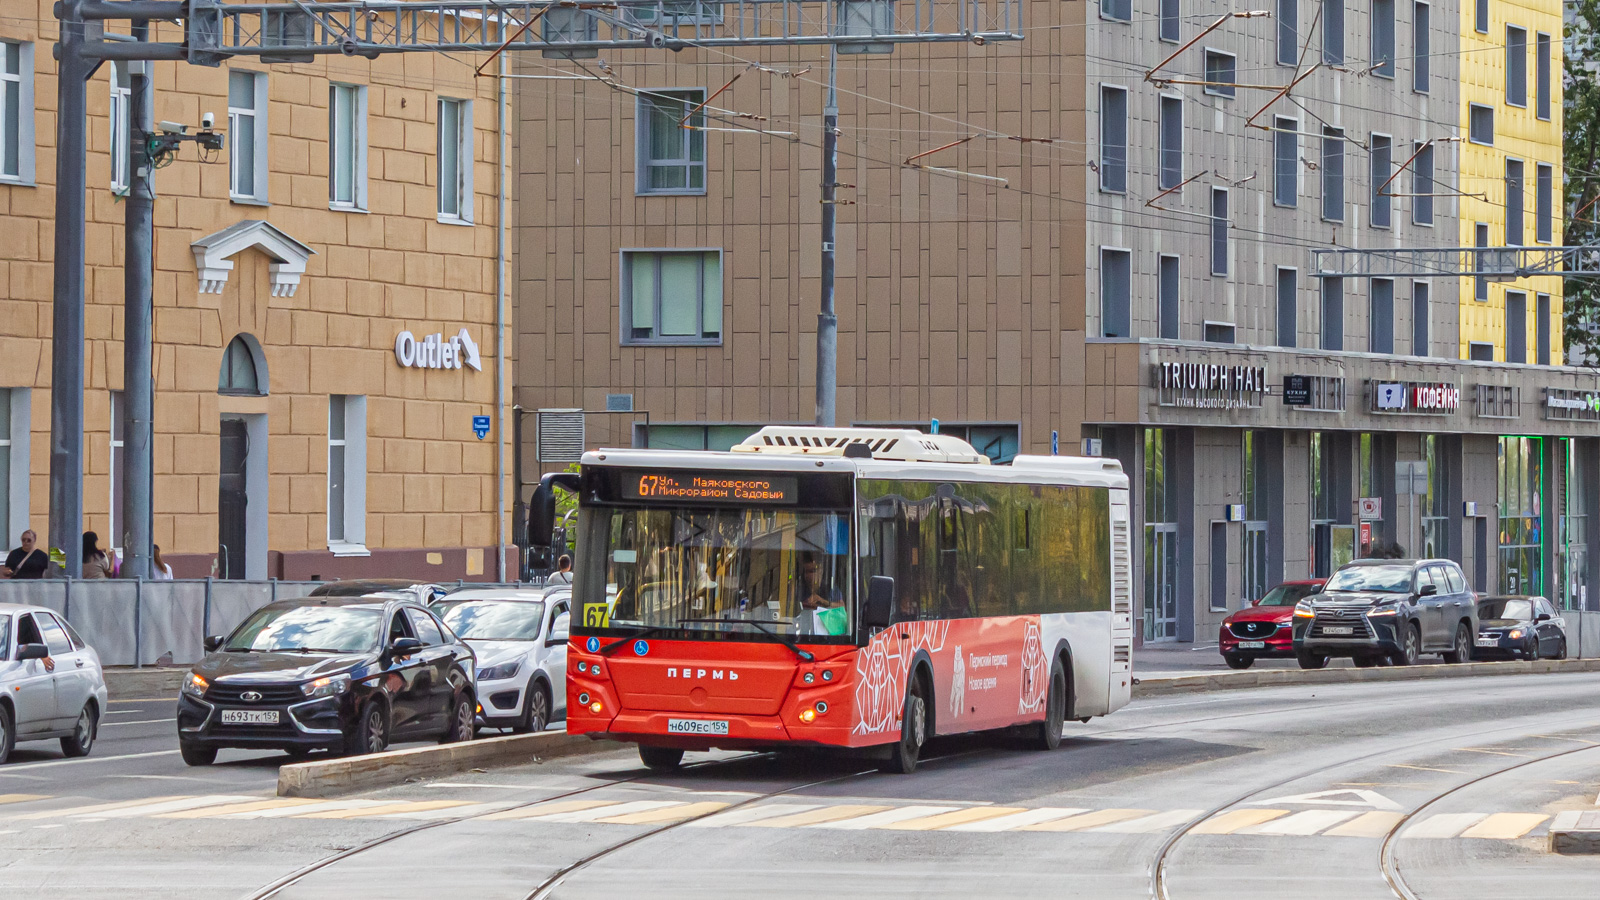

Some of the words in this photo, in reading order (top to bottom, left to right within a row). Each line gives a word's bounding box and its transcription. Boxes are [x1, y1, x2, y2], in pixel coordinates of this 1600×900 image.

[395, 330, 461, 369] Outlet
[1162, 362, 1228, 390] TRIUMPH
[1235, 365, 1270, 392] HALL
[1176, 397, 1194, 407] КУХНИ
[1196, 398, 1225, 409] ВЫСОКОГО
[1226, 399, 1250, 410] ДИЗАЙНА
[1417, 383, 1460, 409] КОФЕЙНЯ
[639, 475, 658, 496] 67
[658, 476, 679, 487] Ул.
[693, 477, 770, 489] Маяковского
[658, 486, 728, 498] Микрорайон
[734, 488, 784, 499] Садовый
[586, 606, 608, 627] 67
[969, 653, 991, 671] Пермский
[992, 654, 1008, 670] период
[667, 668, 739, 680] ПЕРМЬ
[968, 676, 982, 690] Новое
[983, 677, 997, 692] время
[224, 711, 260, 721] Н693ТК
[262, 711, 277, 720] 159
[672, 721, 709, 732] Н609ЕС
[711, 722, 725, 730] 159
